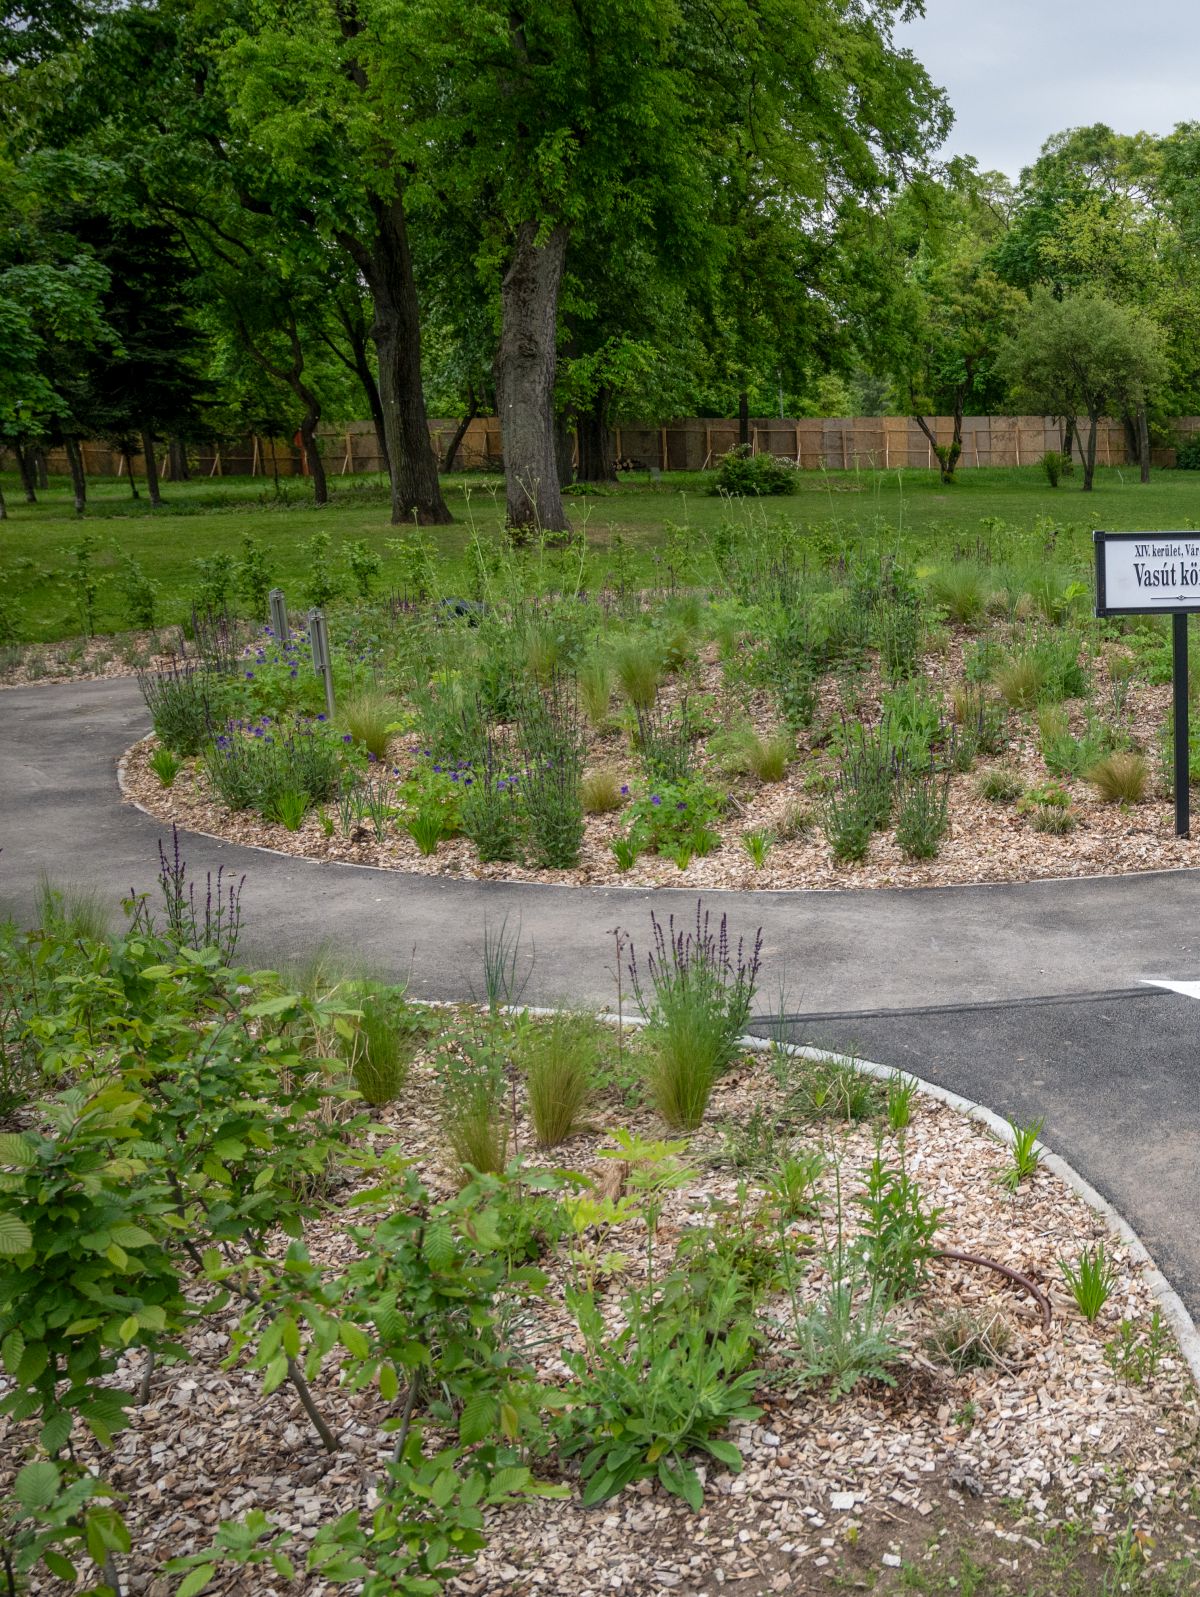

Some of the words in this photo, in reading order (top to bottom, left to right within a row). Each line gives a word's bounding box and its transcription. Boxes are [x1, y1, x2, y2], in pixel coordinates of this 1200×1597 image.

[1134, 544, 1151, 557] XIV.
[1152, 544, 1184, 558] kerület,
[1133, 561, 1177, 587] Vasút
